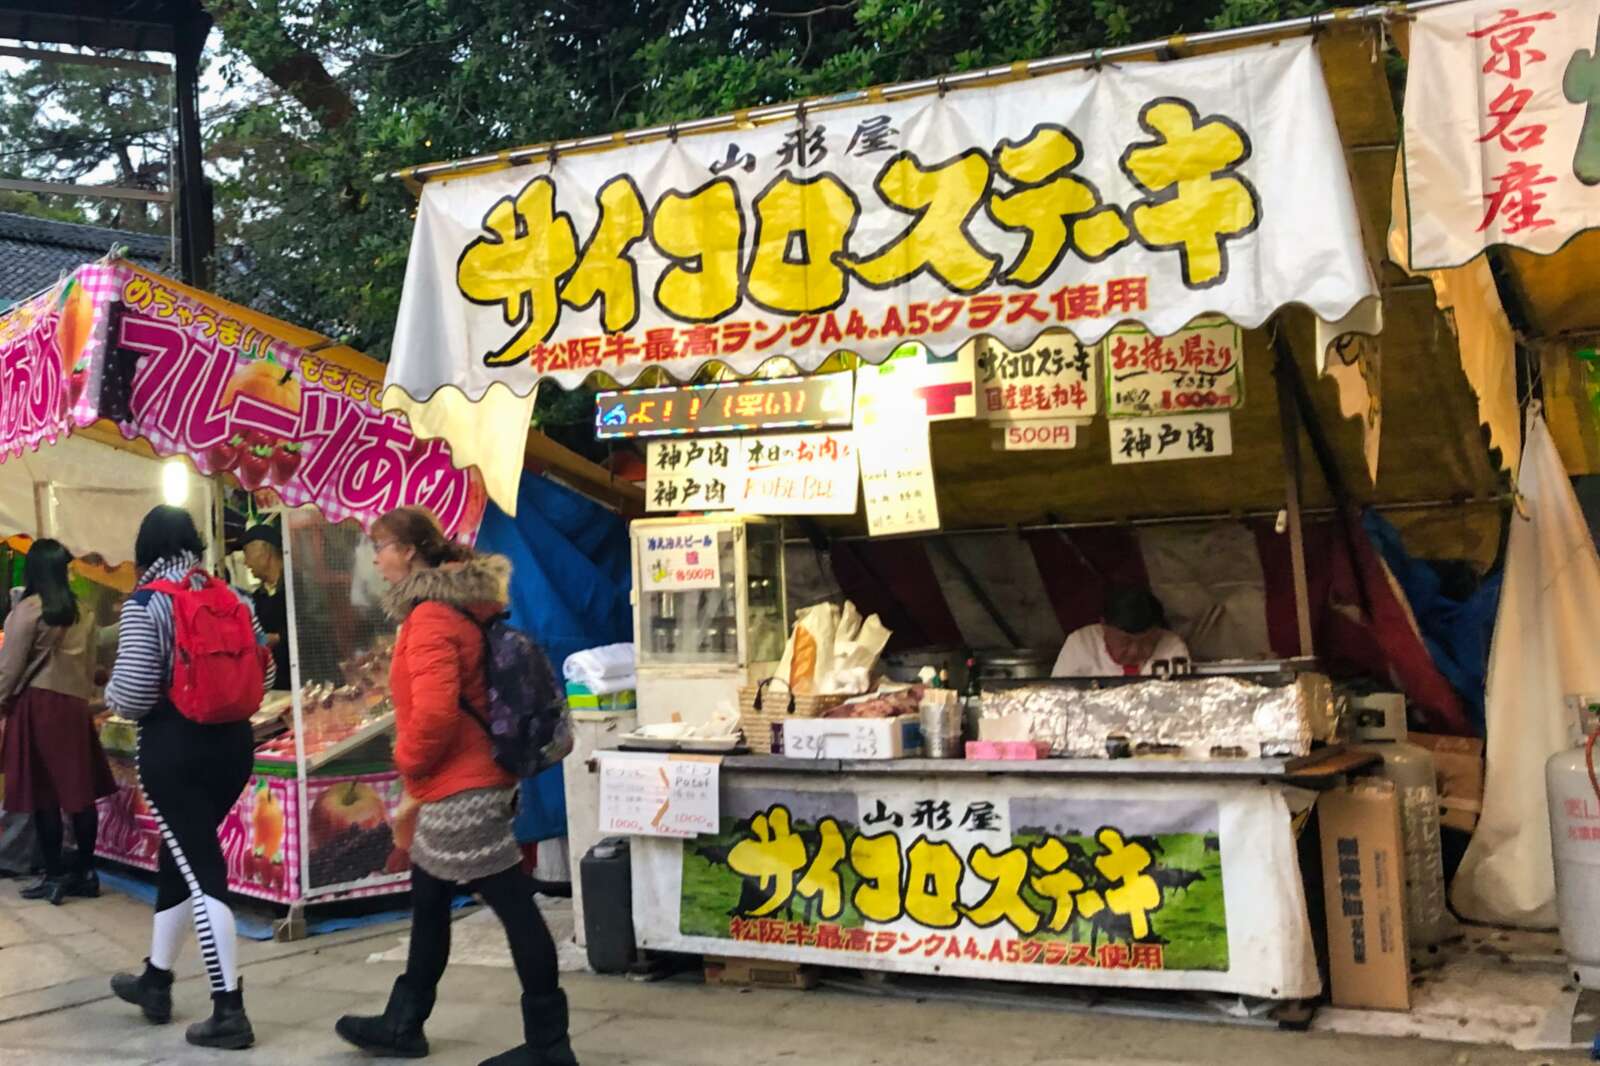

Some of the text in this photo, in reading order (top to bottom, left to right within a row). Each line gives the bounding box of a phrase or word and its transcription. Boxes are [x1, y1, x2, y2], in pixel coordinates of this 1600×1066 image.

[1466, 8, 1557, 234] 京名産
[709, 115, 900, 175] 山形屋
[456, 97, 1264, 367] サイコロステーキ
[977, 342, 1091, 383] サイコロステーキ
[984, 380, 1088, 411] 国産黒毛和牛
[118, 317, 470, 540] フルーツあめ
[1009, 425, 1070, 444] 500円
[1121, 420, 1214, 457] 神戸肉
[655, 440, 729, 470] 神戸肉
[652, 477, 726, 508] 神戸肉
[863, 799, 1003, 832] 山形屋
[727, 803, 1164, 942] サイコロステーキ
